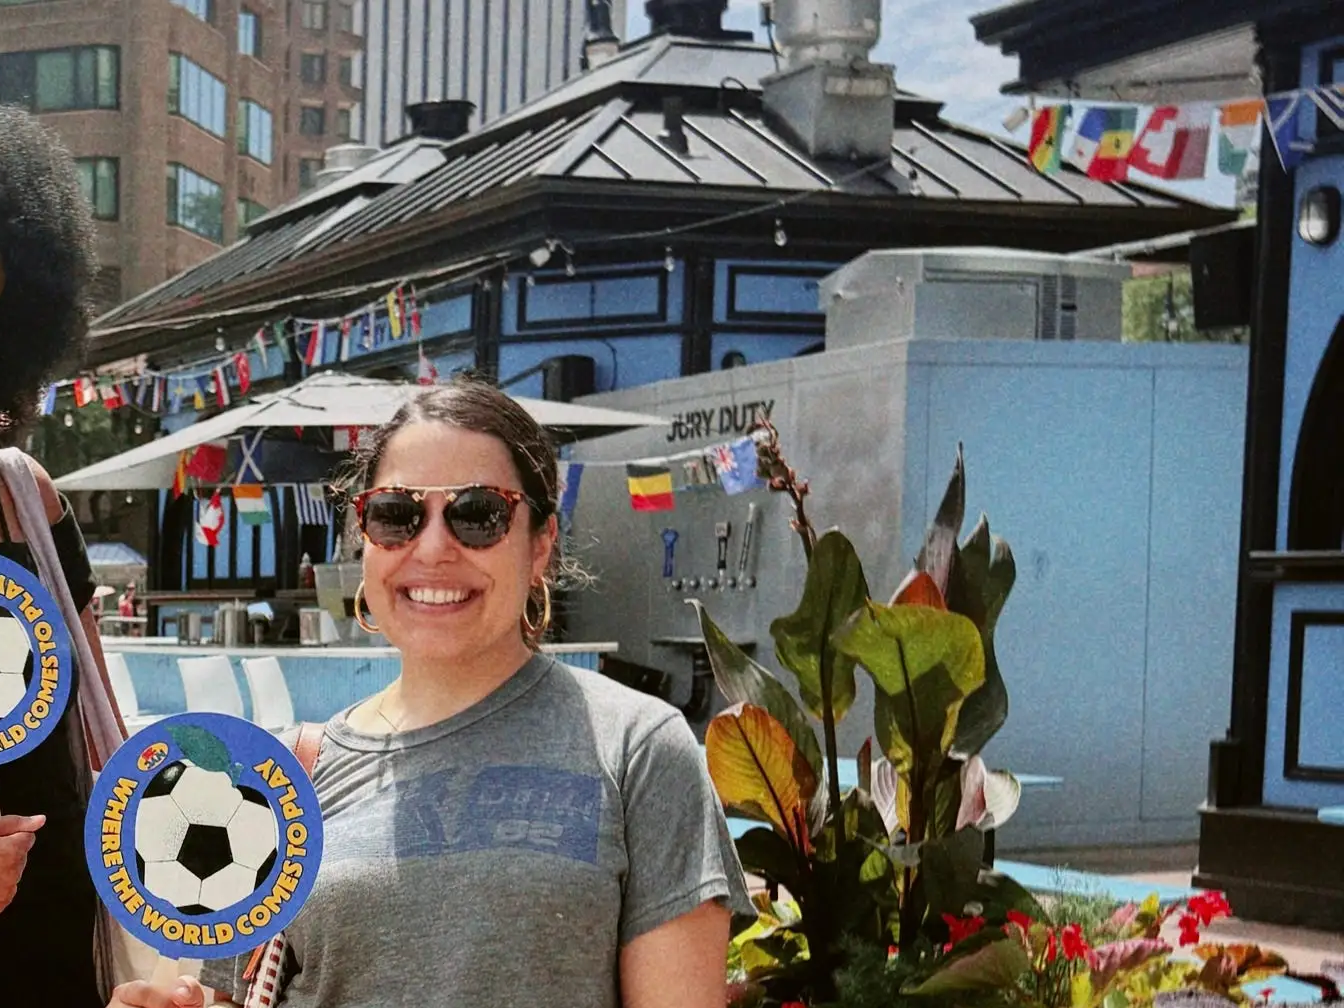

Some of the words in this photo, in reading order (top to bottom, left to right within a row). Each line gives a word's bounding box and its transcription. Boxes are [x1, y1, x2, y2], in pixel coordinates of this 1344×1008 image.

[667, 408, 715, 442] JURY
[719, 400, 775, 434] DUTY
[33, 621, 57, 654] TO
[23, 655, 59, 729] COMES
[253, 757, 304, 820] PLAY
[101, 777, 138, 868] WHERE
[286, 822, 308, 858] TO
[108, 867, 144, 914] THE
[235, 860, 304, 936] COMES
[141, 904, 235, 945] WORLD
